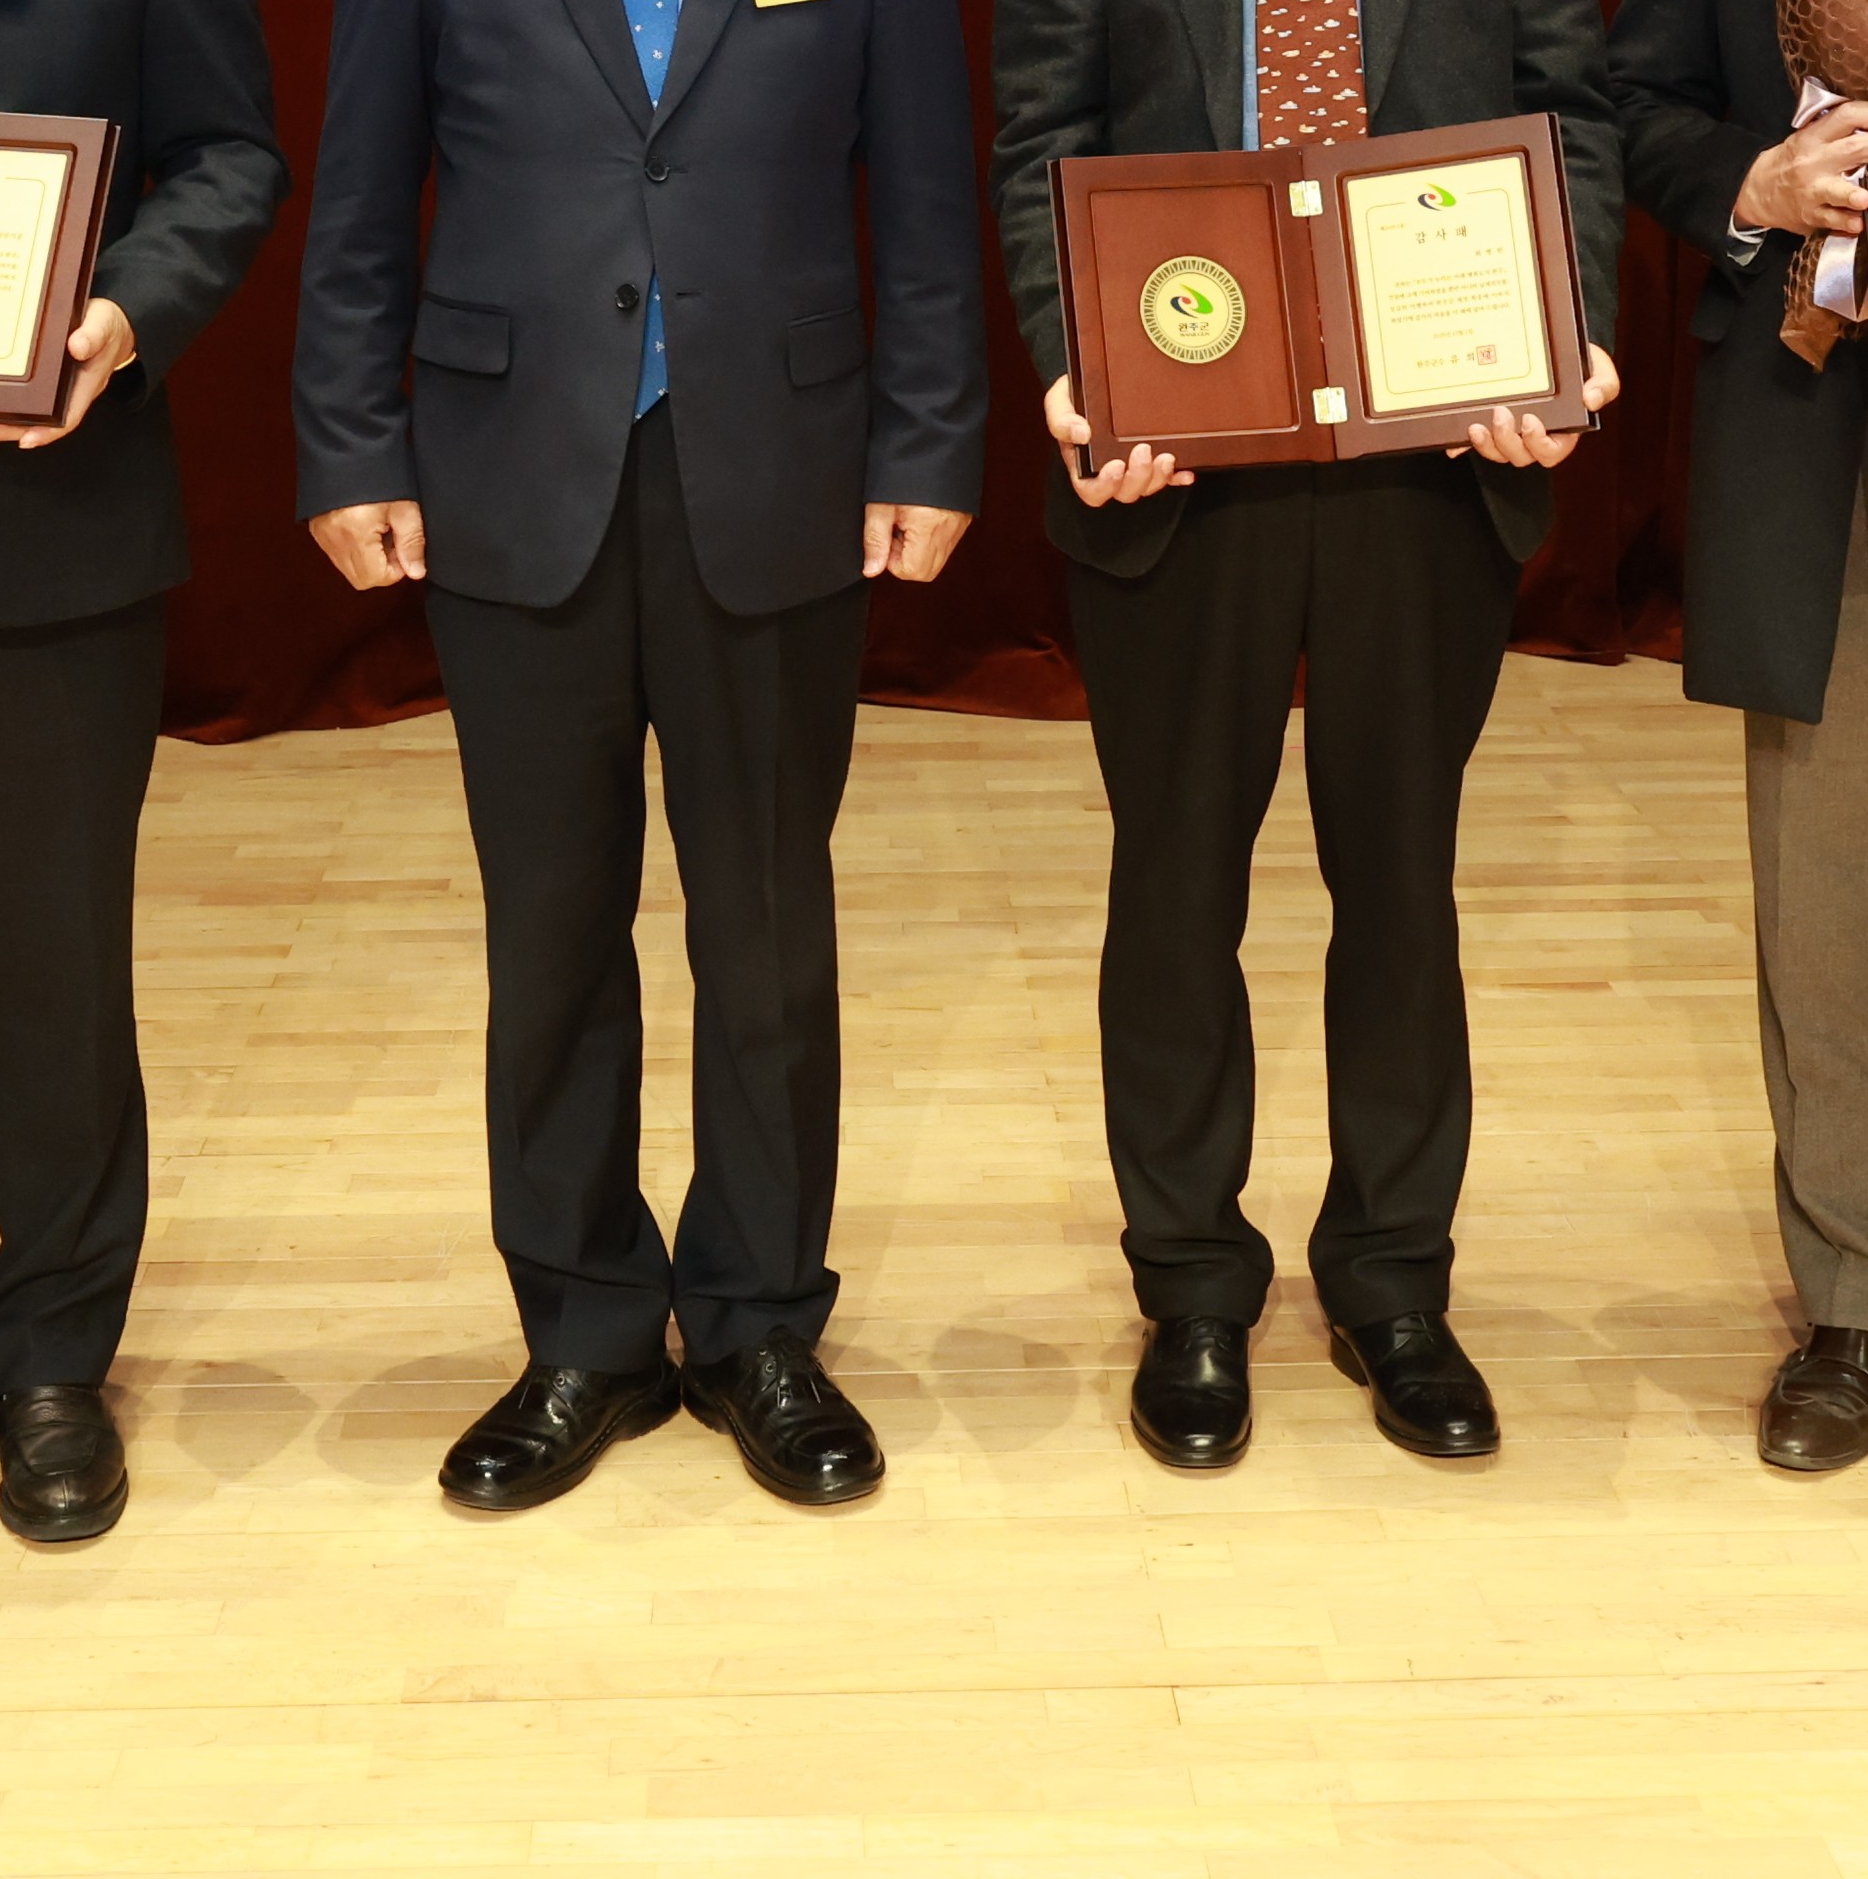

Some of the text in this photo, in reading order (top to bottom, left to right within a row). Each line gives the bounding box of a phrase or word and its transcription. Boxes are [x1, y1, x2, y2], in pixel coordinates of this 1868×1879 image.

[1416, 225, 1467, 244] 감 사 패
[1178, 322, 1209, 332] 완주군
